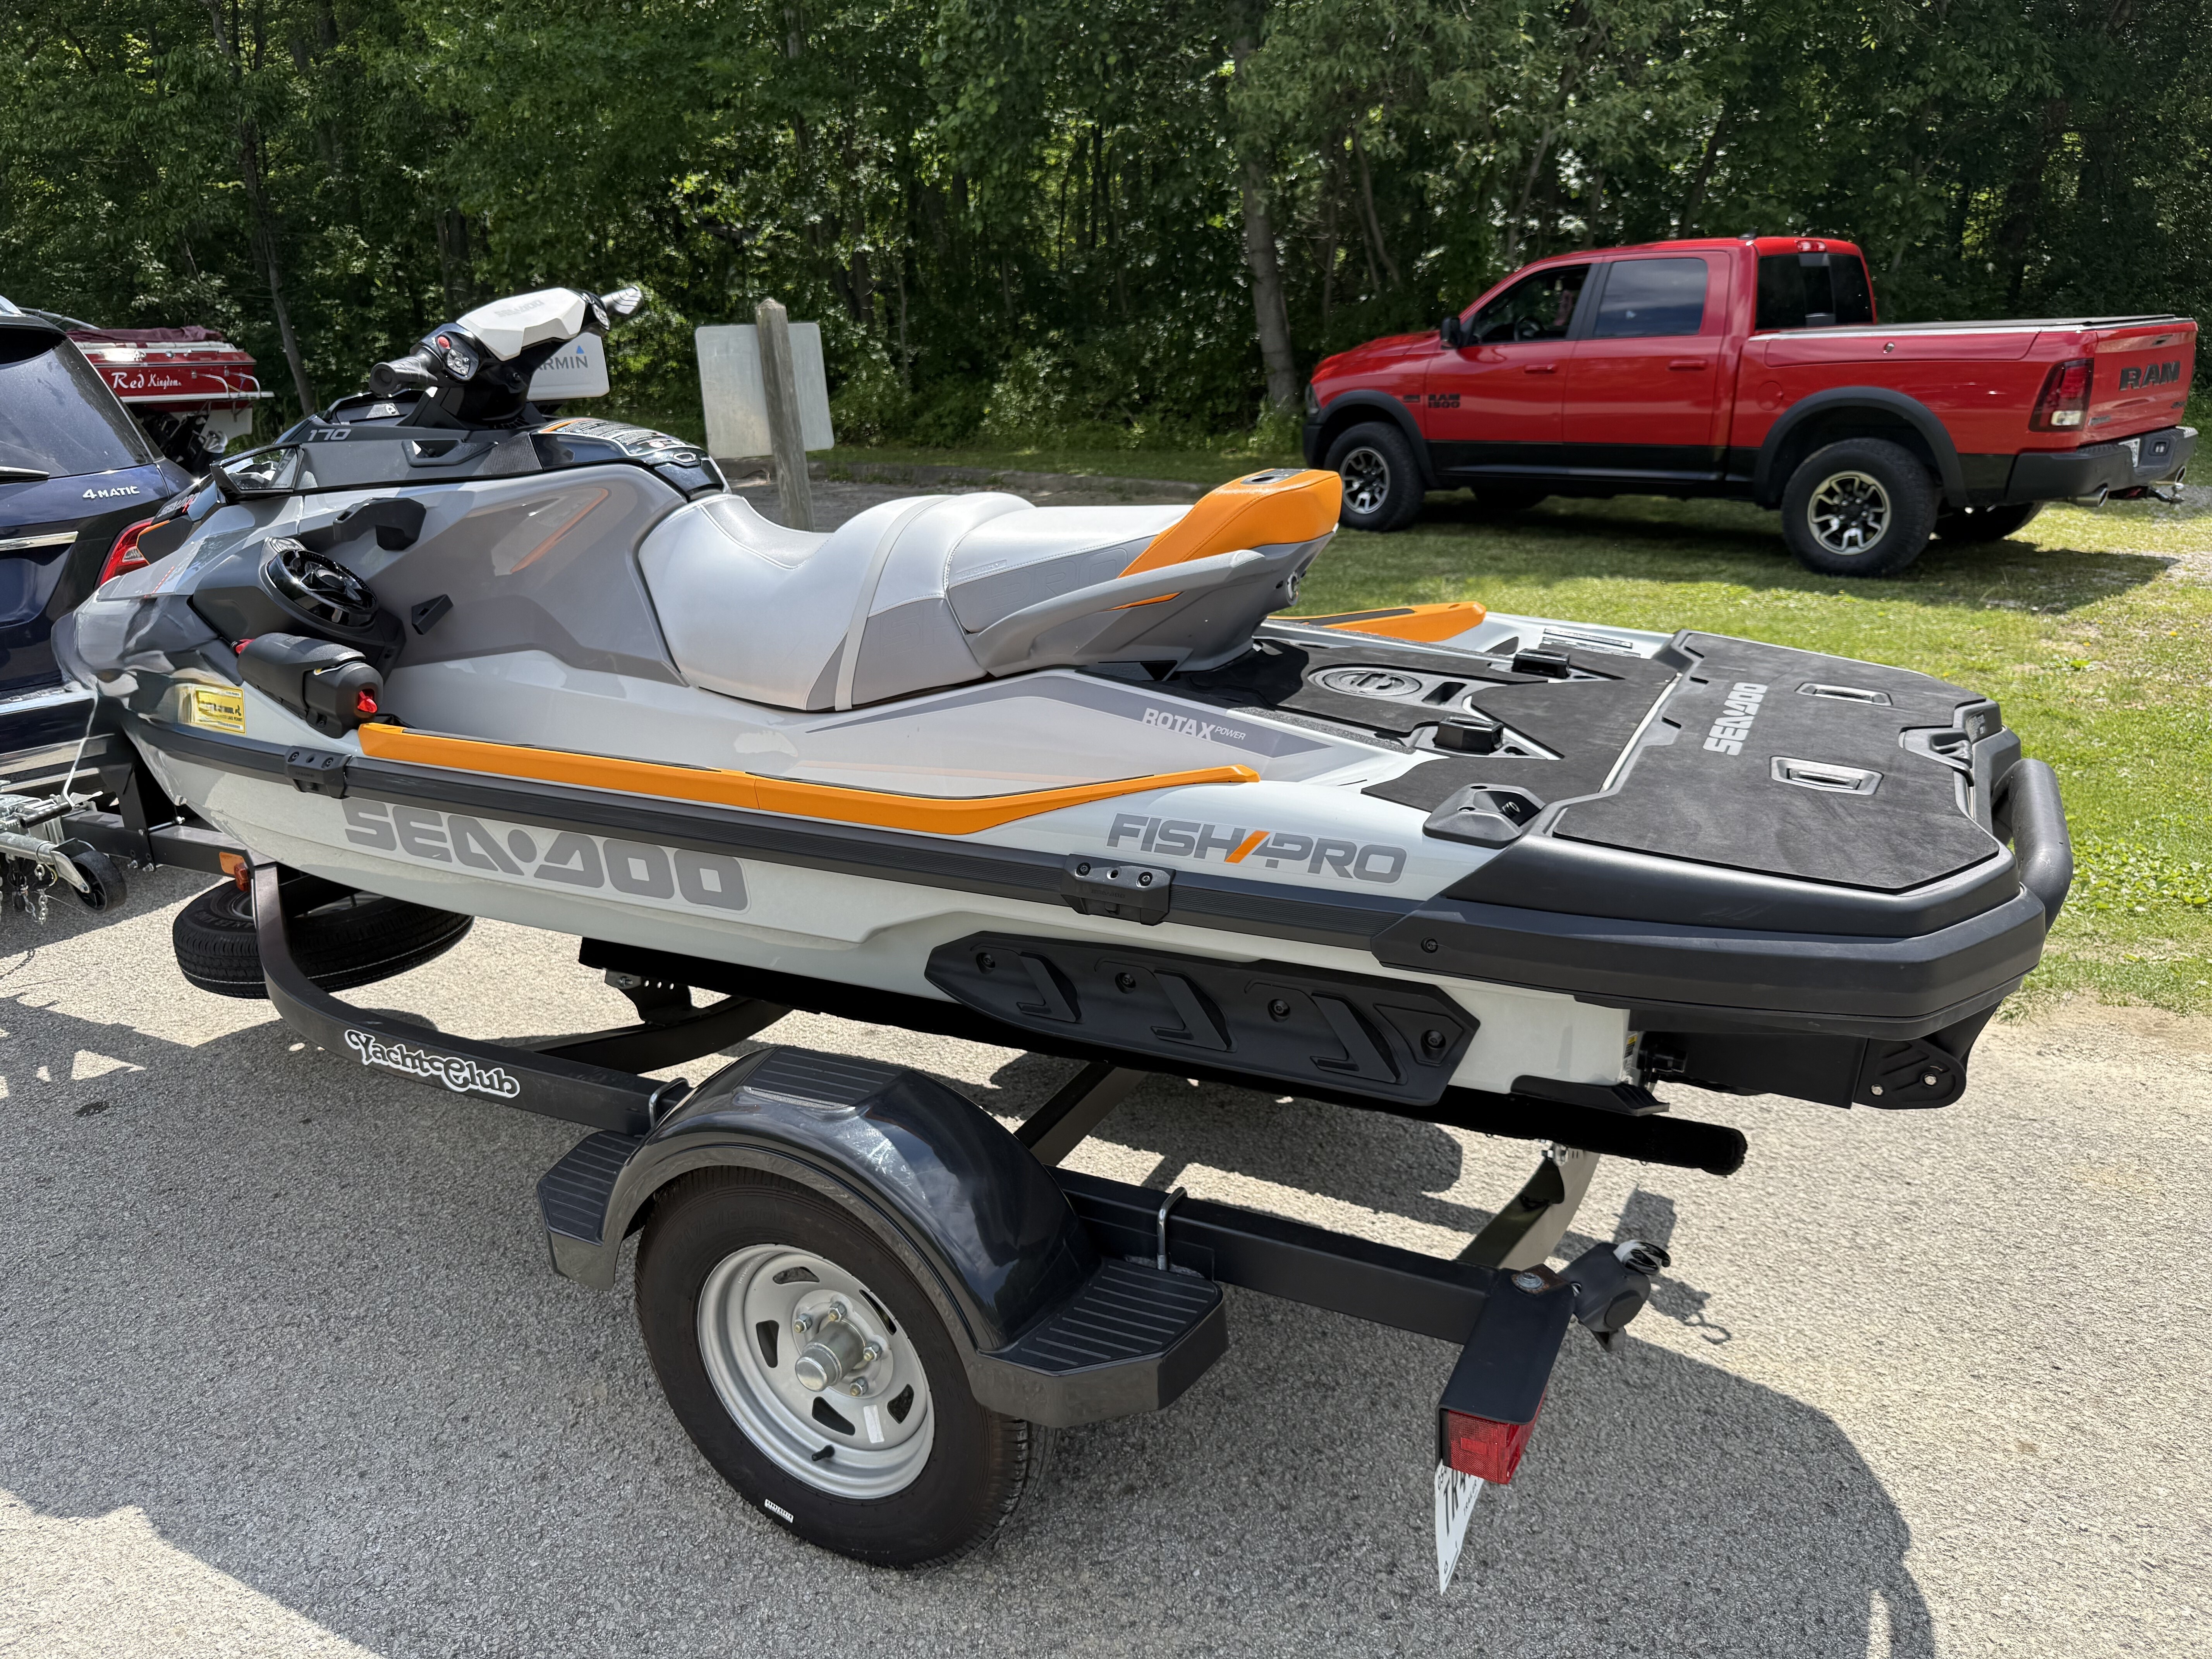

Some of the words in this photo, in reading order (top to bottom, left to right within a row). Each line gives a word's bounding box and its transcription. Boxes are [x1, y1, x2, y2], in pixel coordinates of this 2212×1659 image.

[538, 355, 588, 371] RMIN
[111, 371, 144, 389] Red
[148, 373, 178, 390] Kingdom
[2119, 361, 2181, 391] RAM
[308, 428, 351, 441] 170
[82, 485, 140, 499] 4MATIC
[1142, 708, 1216, 740] ROTAX
[1214, 726, 1246, 740] POWER
